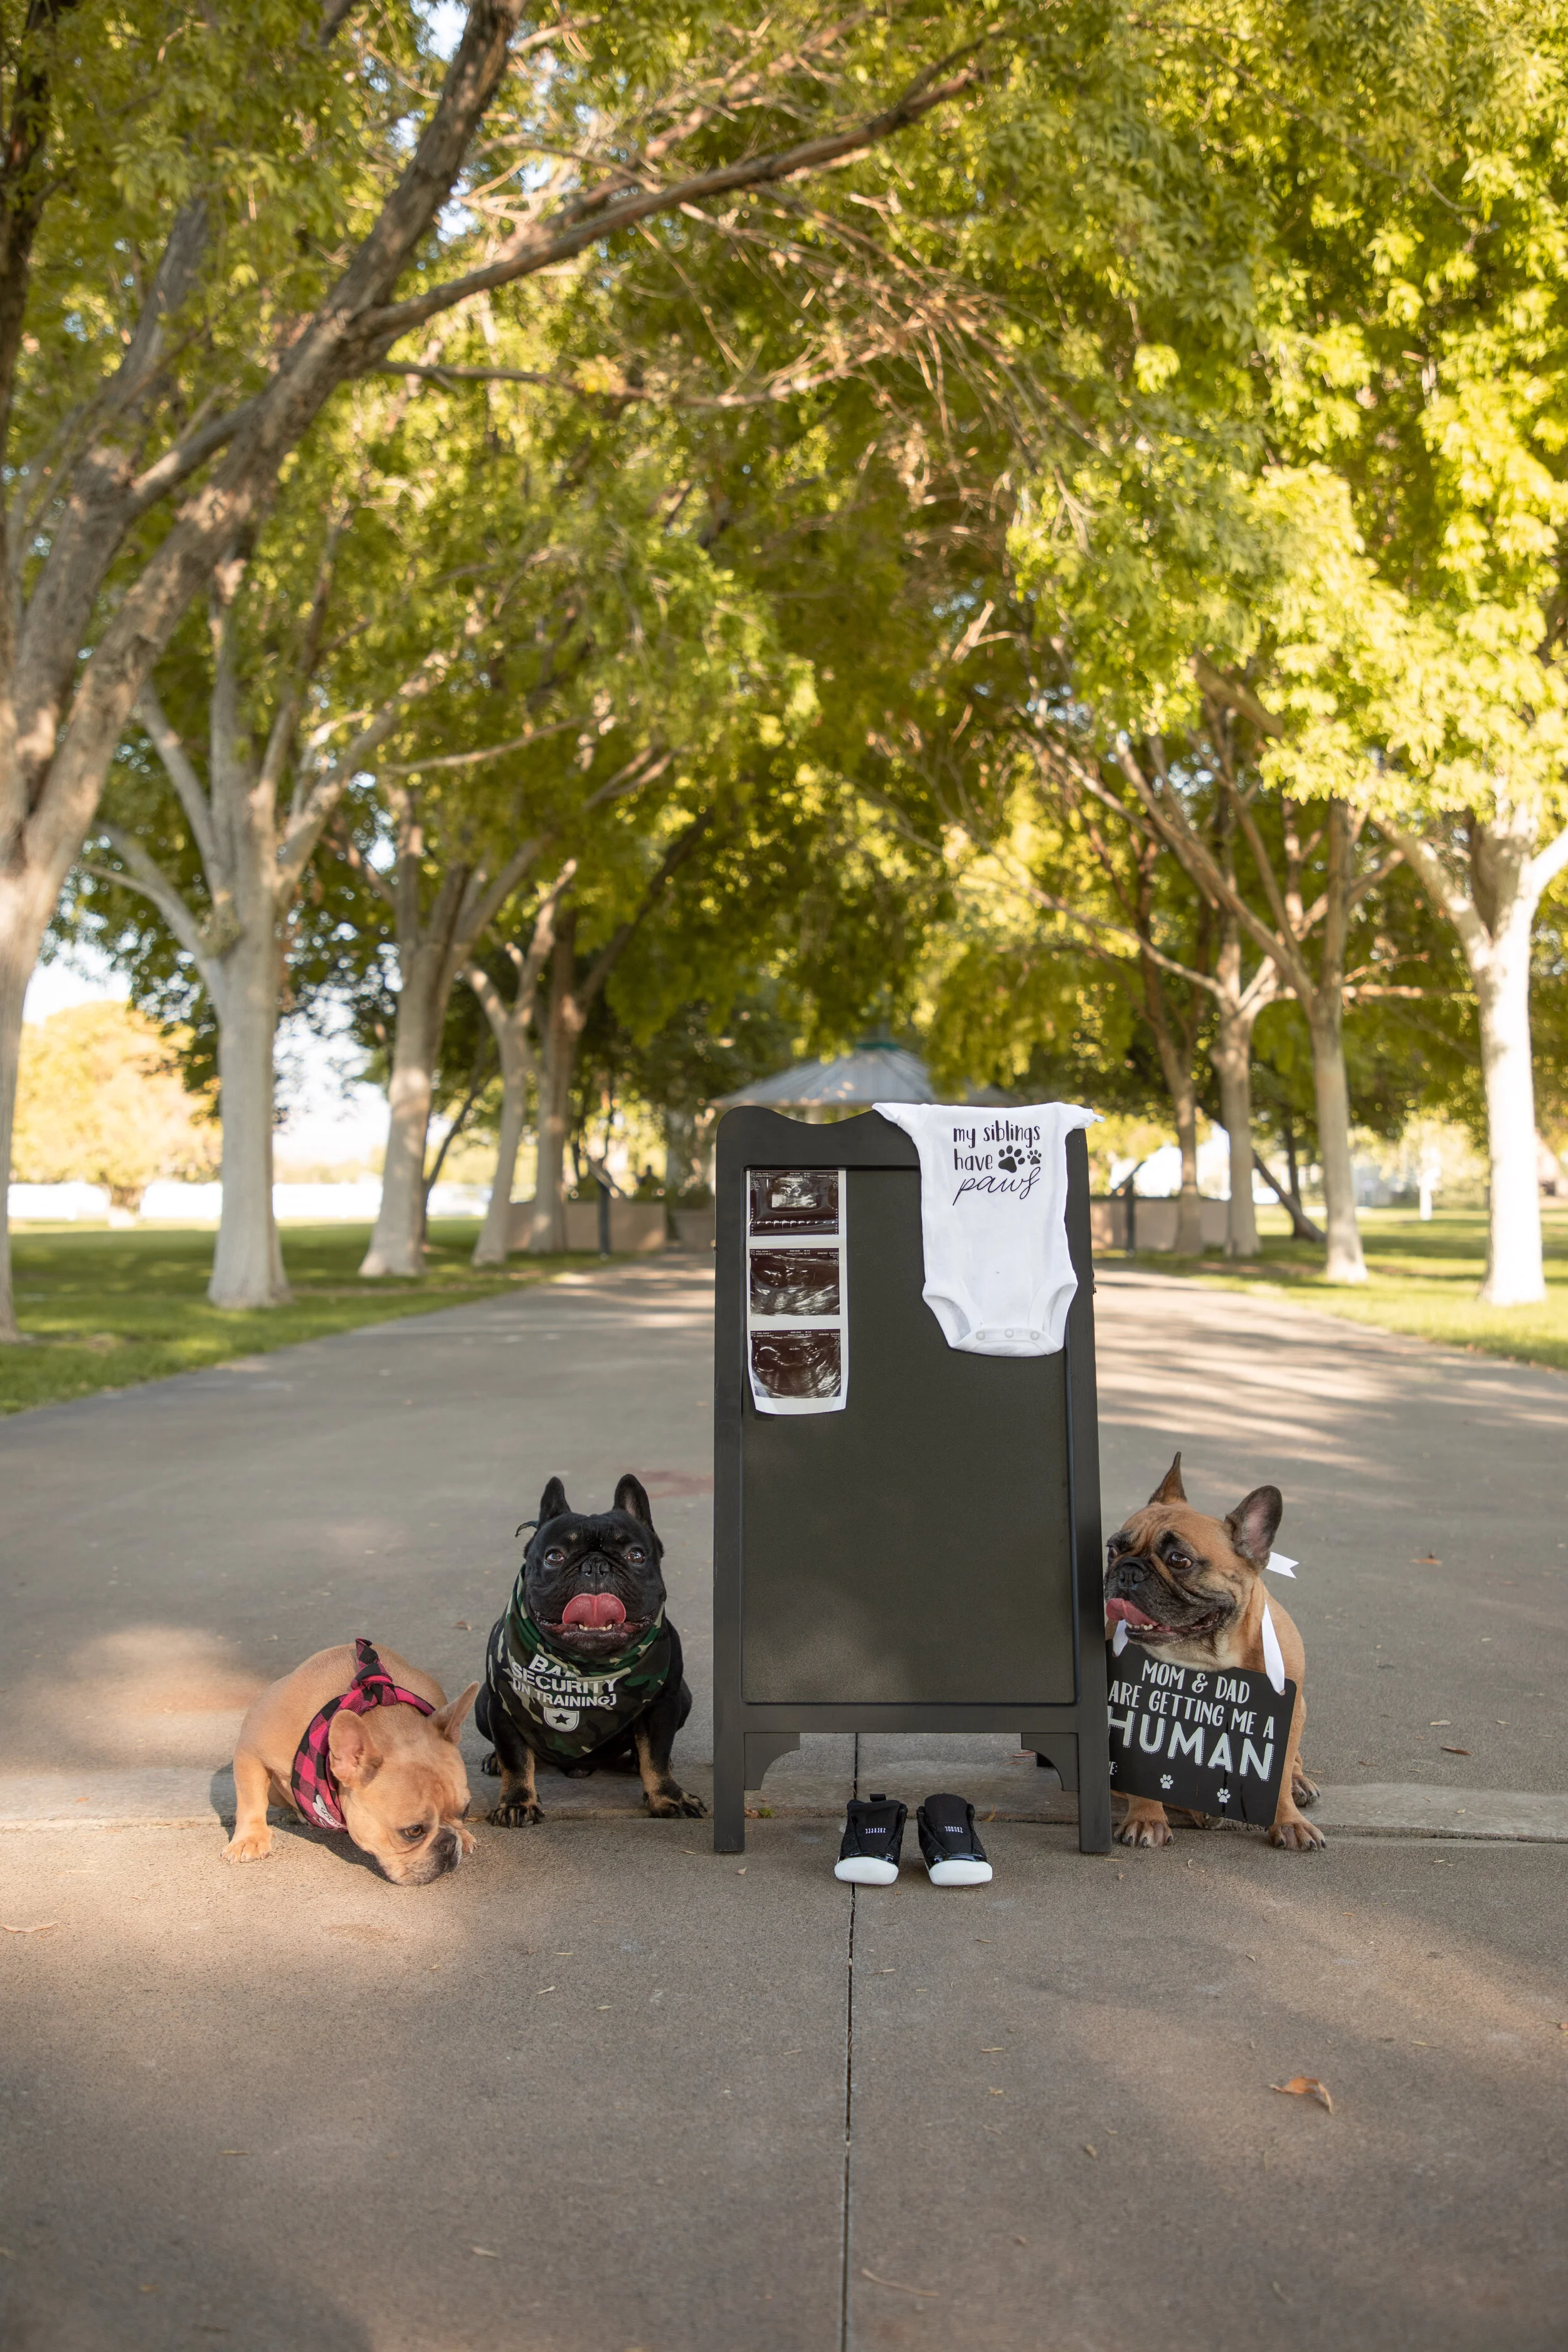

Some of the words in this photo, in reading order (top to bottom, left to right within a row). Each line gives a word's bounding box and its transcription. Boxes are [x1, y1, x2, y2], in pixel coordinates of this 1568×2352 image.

[953, 1127, 976, 1148] my
[983, 1120, 1041, 1148] siblings
[953, 1148, 993, 1171] have
[952, 1167, 1041, 1205] paws
[511, 1661, 619, 1693] SECURITY
[1141, 1660, 1185, 1690] MOM
[1192, 1673, 1208, 1693] &
[1214, 1675, 1250, 1704] DAD
[1108, 1680, 1143, 1708] ARE
[1148, 1690, 1224, 1727] GETTING
[1231, 1708, 1258, 1735] ME
[1263, 1716, 1274, 1739] A
[1108, 1705, 1274, 1781] HUMAN
[320, 1807, 341, 1826] SOON
